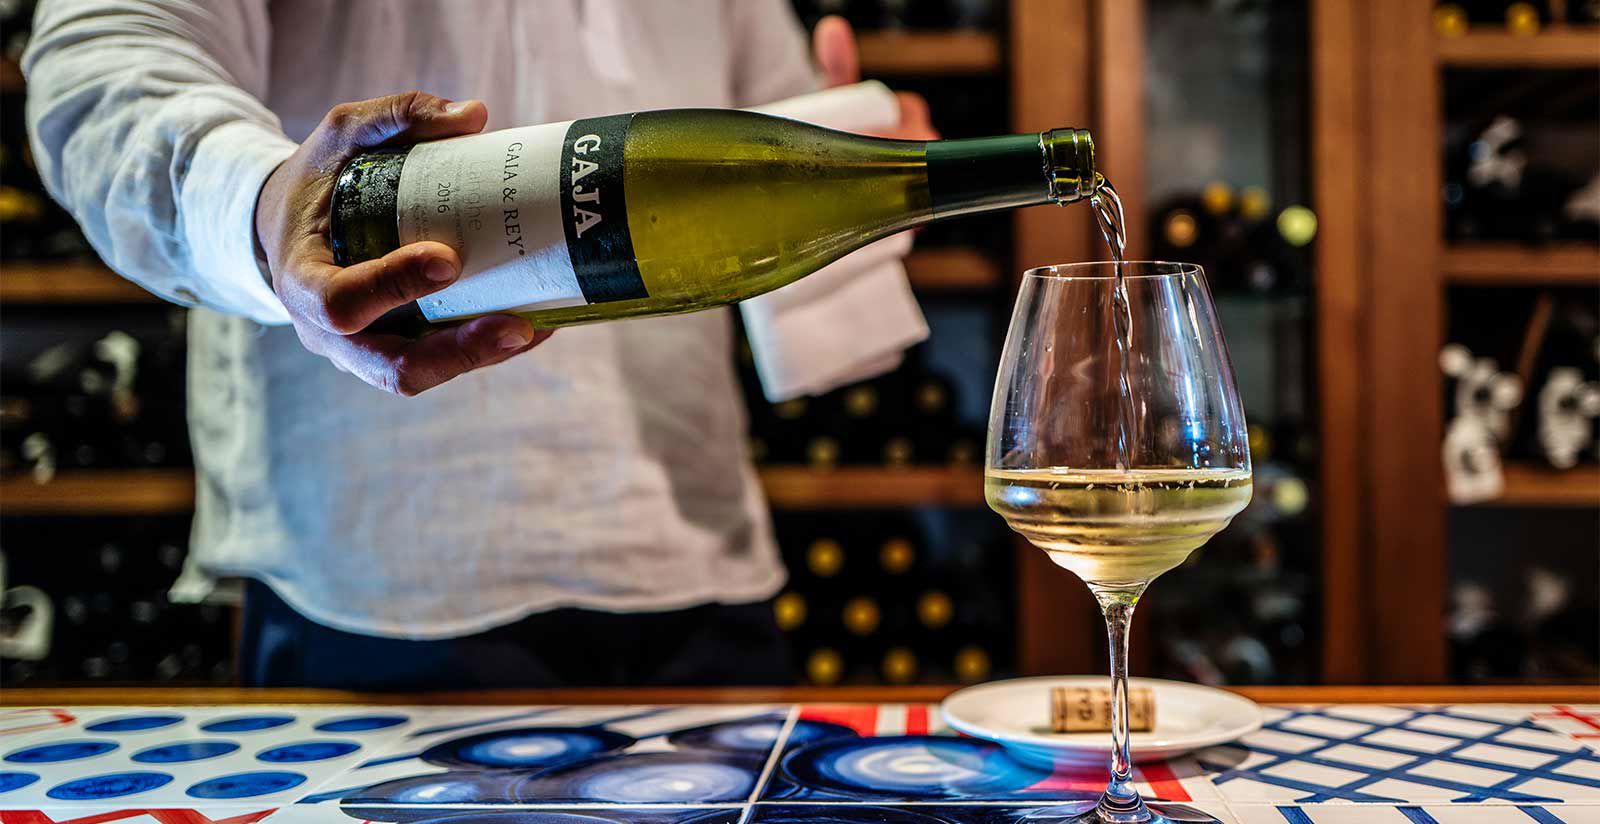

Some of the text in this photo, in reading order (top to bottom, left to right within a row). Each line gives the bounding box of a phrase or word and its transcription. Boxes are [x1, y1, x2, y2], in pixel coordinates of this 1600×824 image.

[504, 142, 522, 181] GAIA
[437, 182, 452, 213] 2016
[503, 187, 517, 204] &
[572, 135, 602, 239] GAJA
